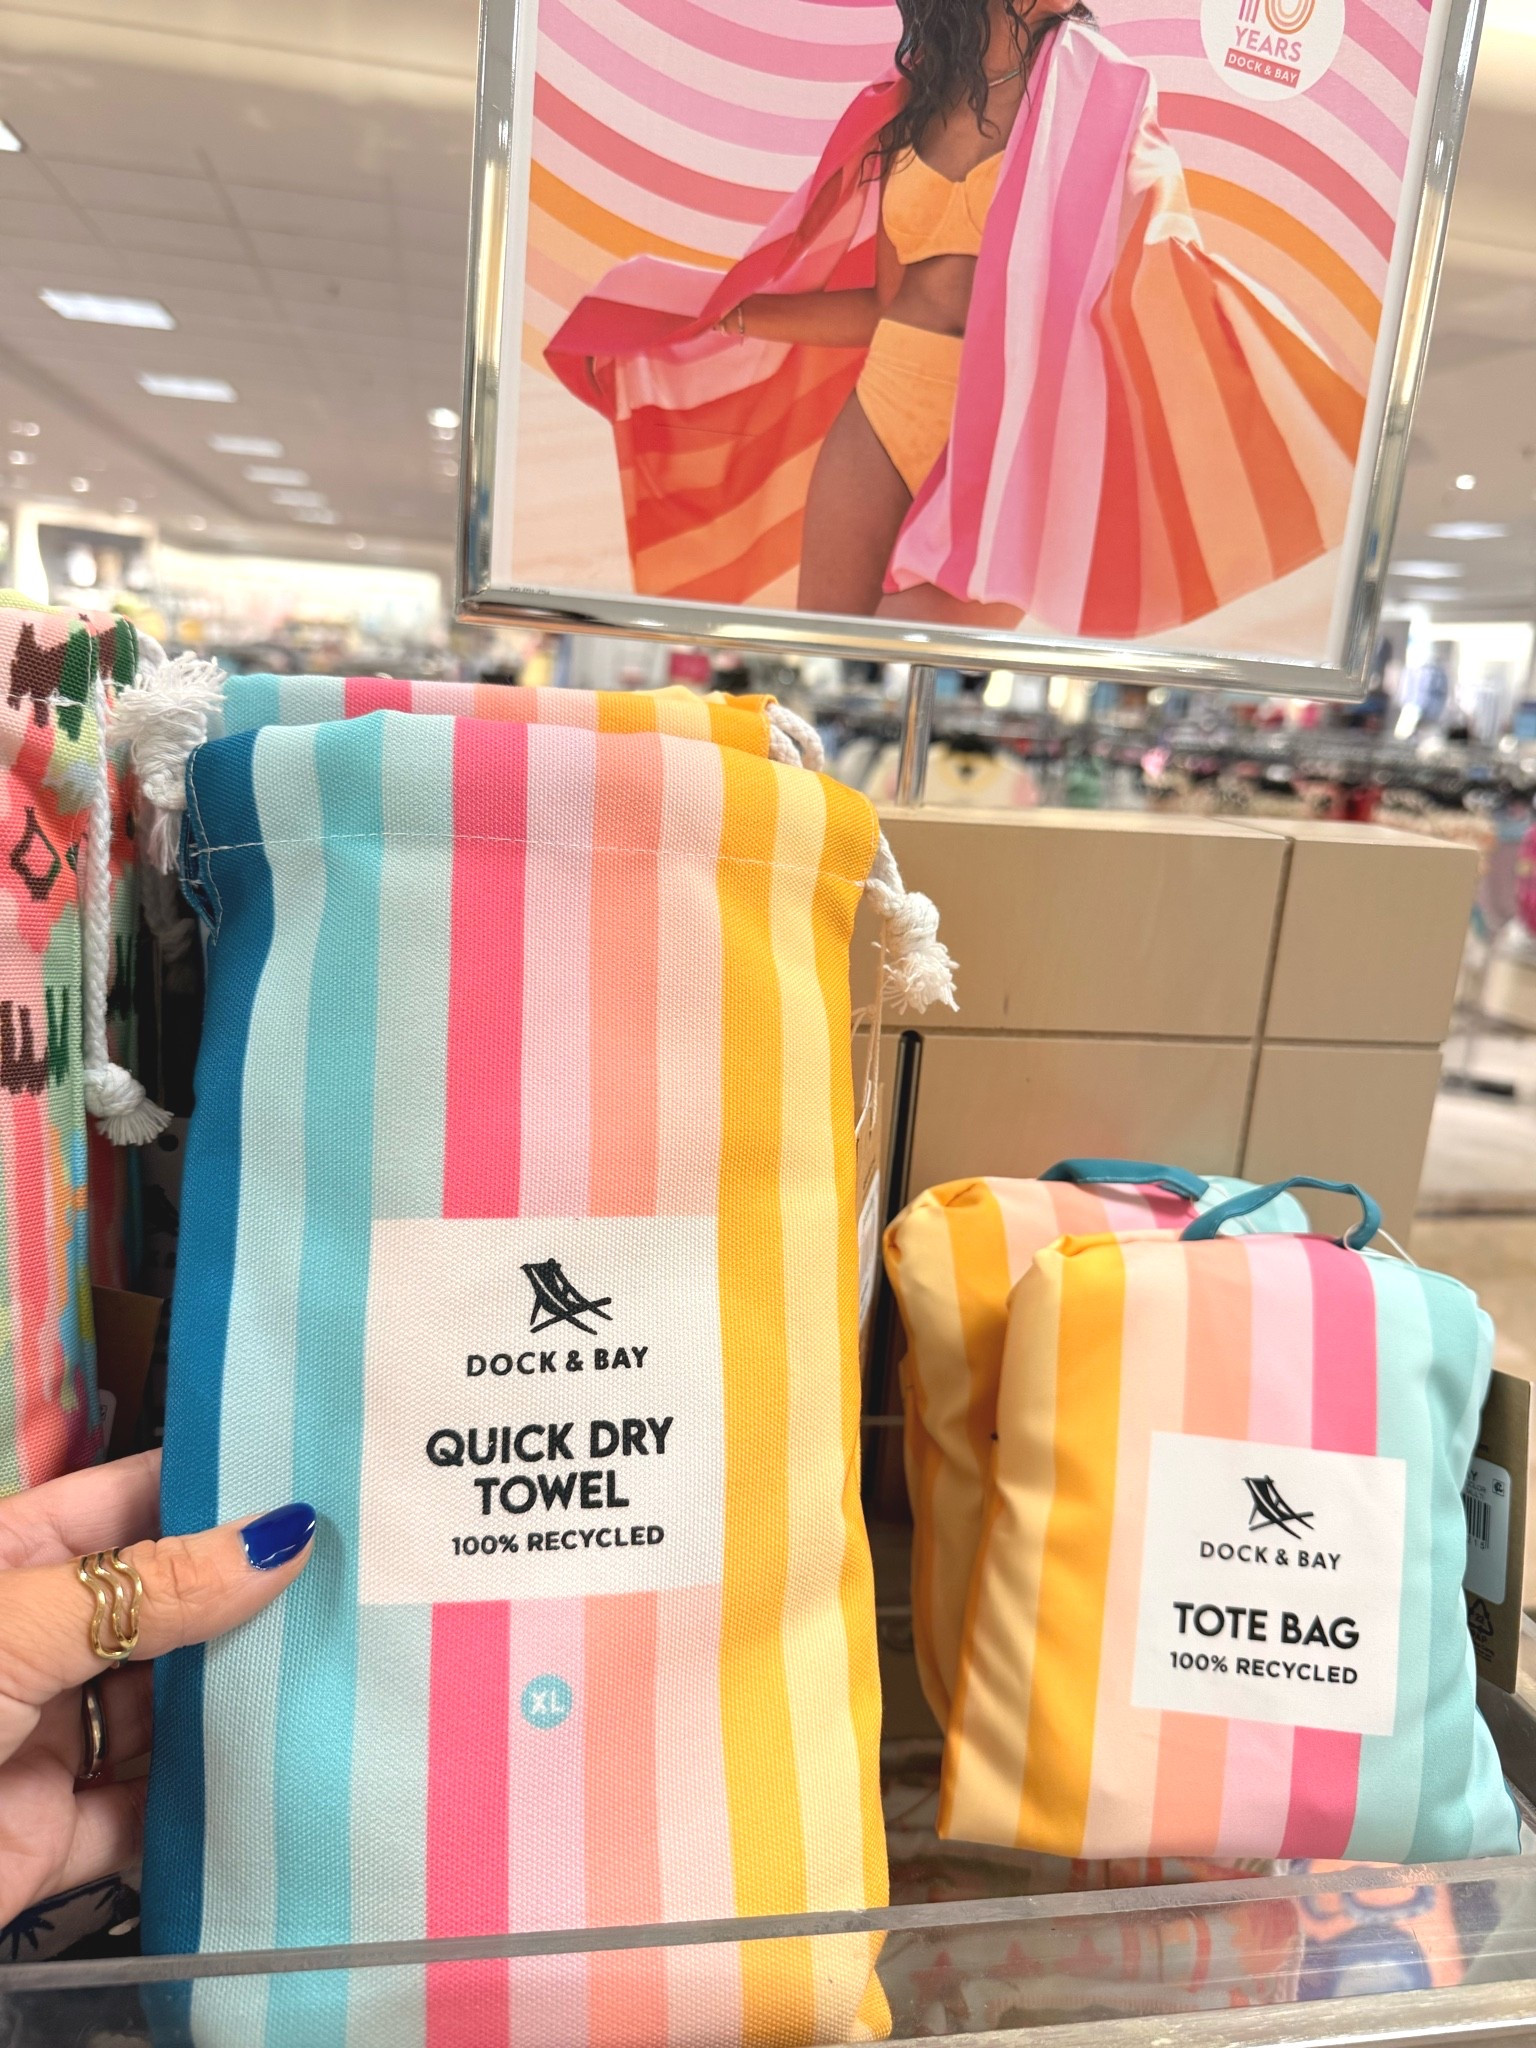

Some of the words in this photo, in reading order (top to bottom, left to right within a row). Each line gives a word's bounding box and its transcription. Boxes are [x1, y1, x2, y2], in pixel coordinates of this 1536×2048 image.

[1235, 25, 1302, 62] YEARS
[1228, 53, 1262, 73] DOCK
[1264, 65, 1272, 76] &
[1274, 68, 1297, 84] BAY
[466, 1350, 557, 1377] DOCK
[565, 1349, 584, 1373] &
[594, 1346, 648, 1371] BAY
[425, 1422, 575, 1468] QUICK
[589, 1416, 674, 1459] DRY
[473, 1469, 630, 1516] TOWEL
[451, 1534, 519, 1556] 100%
[527, 1525, 665, 1553] RECYCLED
[1199, 1540, 1268, 1564] DOCK
[1274, 1548, 1289, 1566] &
[1298, 1550, 1342, 1570] BAY
[1173, 1601, 1268, 1642] TOTE
[1280, 1611, 1360, 1650] BAG
[1170, 1651, 1228, 1673] 100%
[1236, 1657, 1358, 1685] RECYCLED
[530, 1690, 564, 1714] XL
